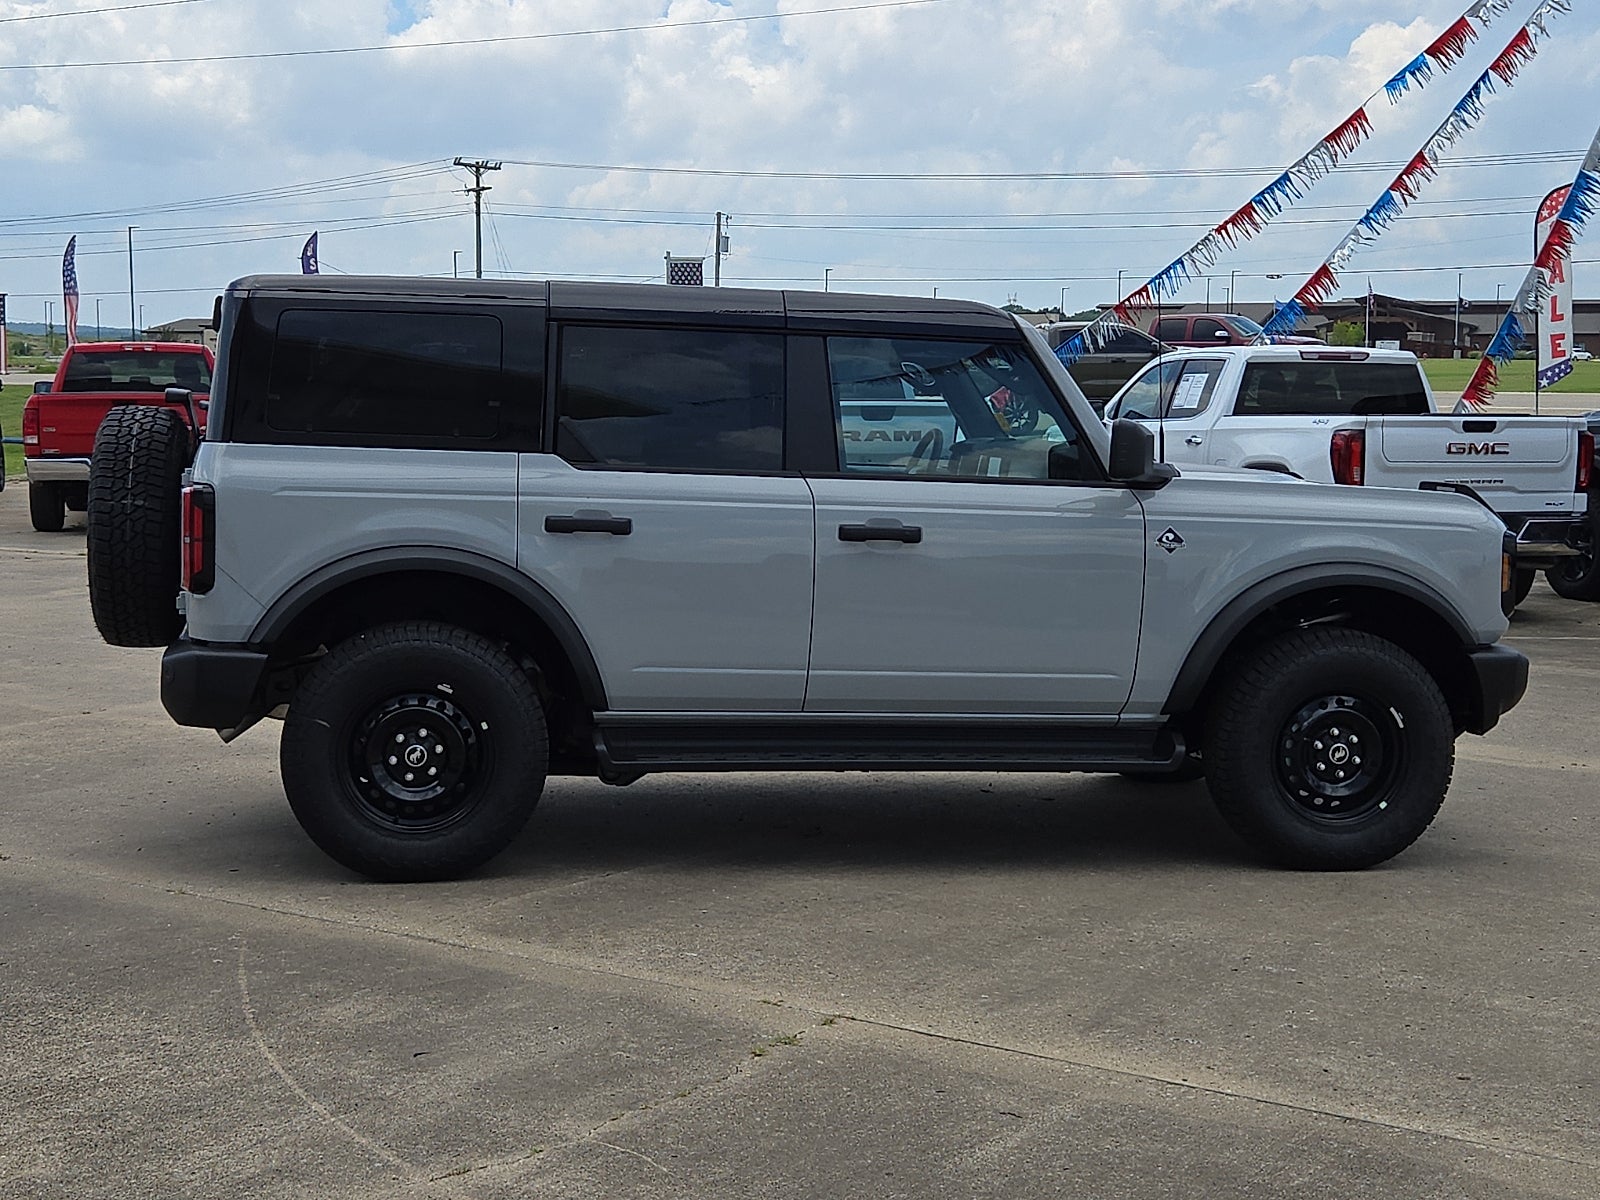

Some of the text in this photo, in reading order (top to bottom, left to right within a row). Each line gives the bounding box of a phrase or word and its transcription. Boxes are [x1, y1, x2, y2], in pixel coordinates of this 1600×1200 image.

[1548, 224, 1567, 360] ALE
[843, 430, 922, 442] RAM
[1446, 442, 1510, 455] GMC
